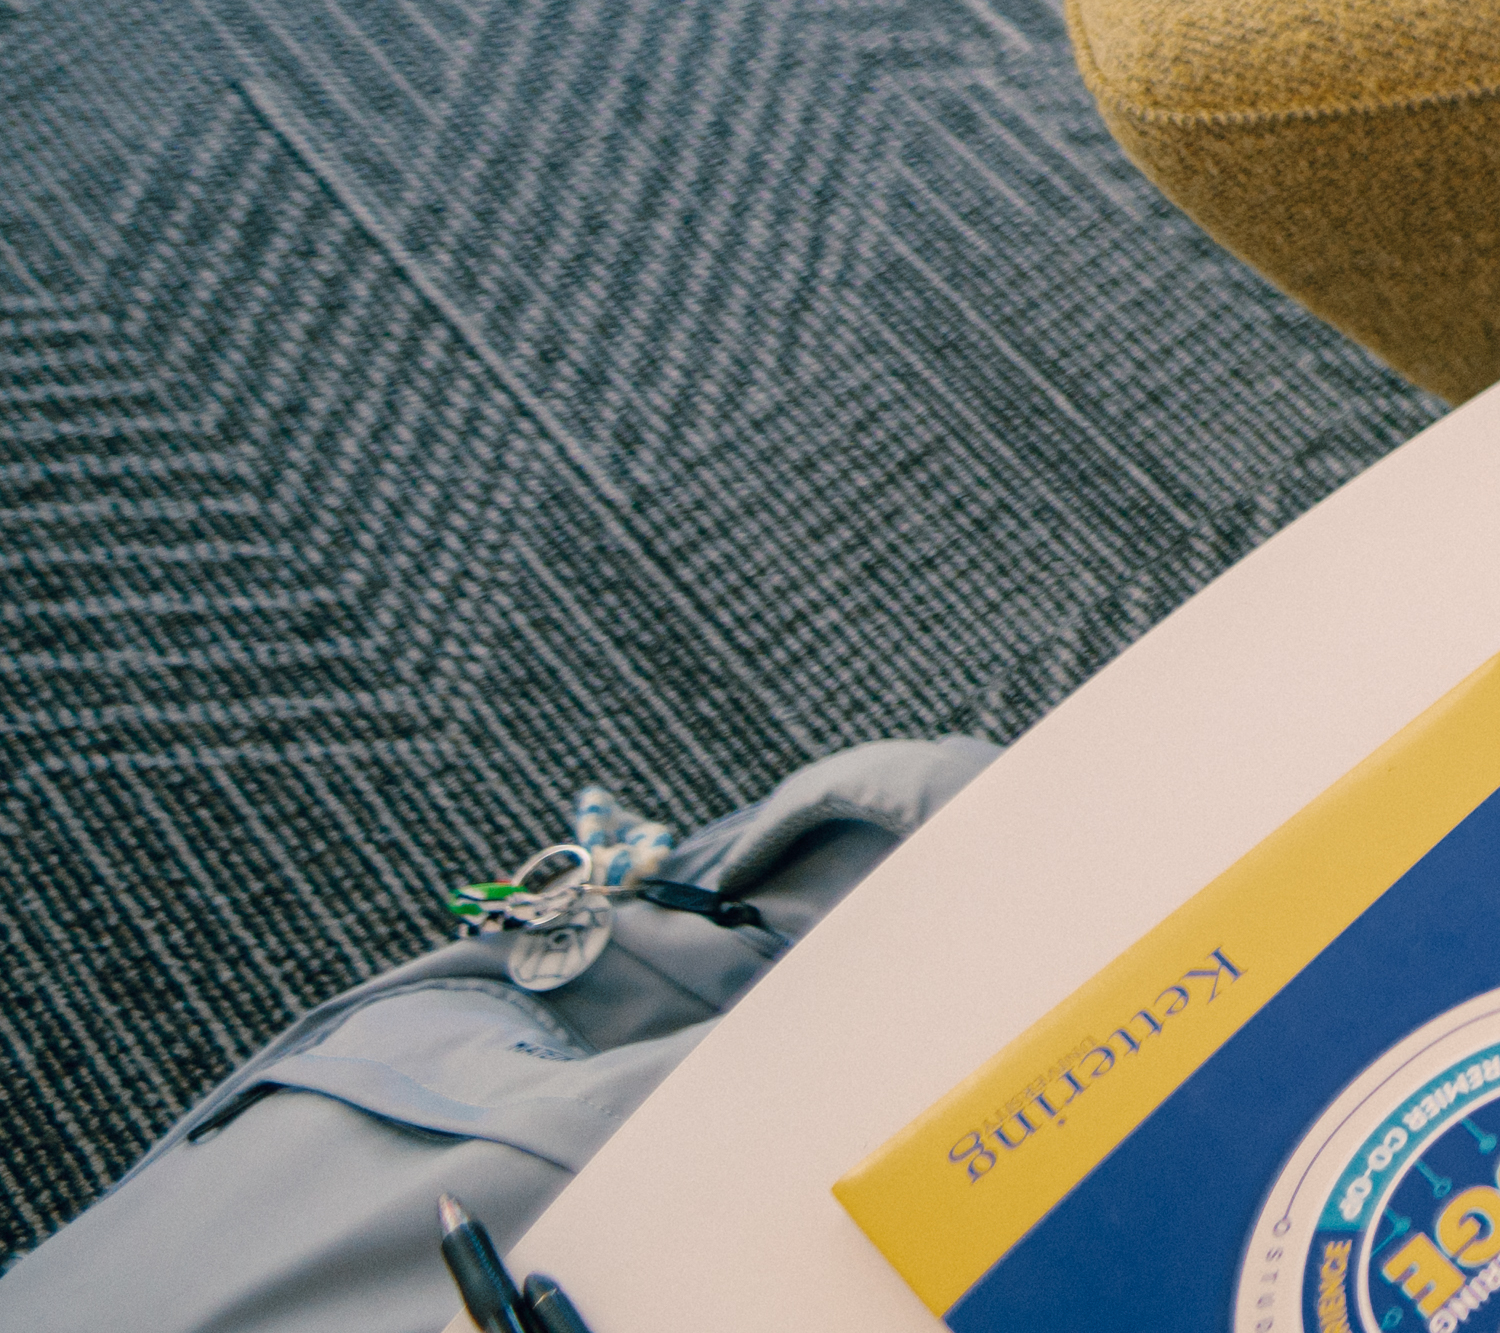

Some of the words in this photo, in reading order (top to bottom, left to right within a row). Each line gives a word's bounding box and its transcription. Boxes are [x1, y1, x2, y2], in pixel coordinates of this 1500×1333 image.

[948, 946, 1248, 1185] Kettering
[983, 1034, 1098, 1133] UNIVERSITY
[1338, 1126, 1408, 1222] CO-OP
